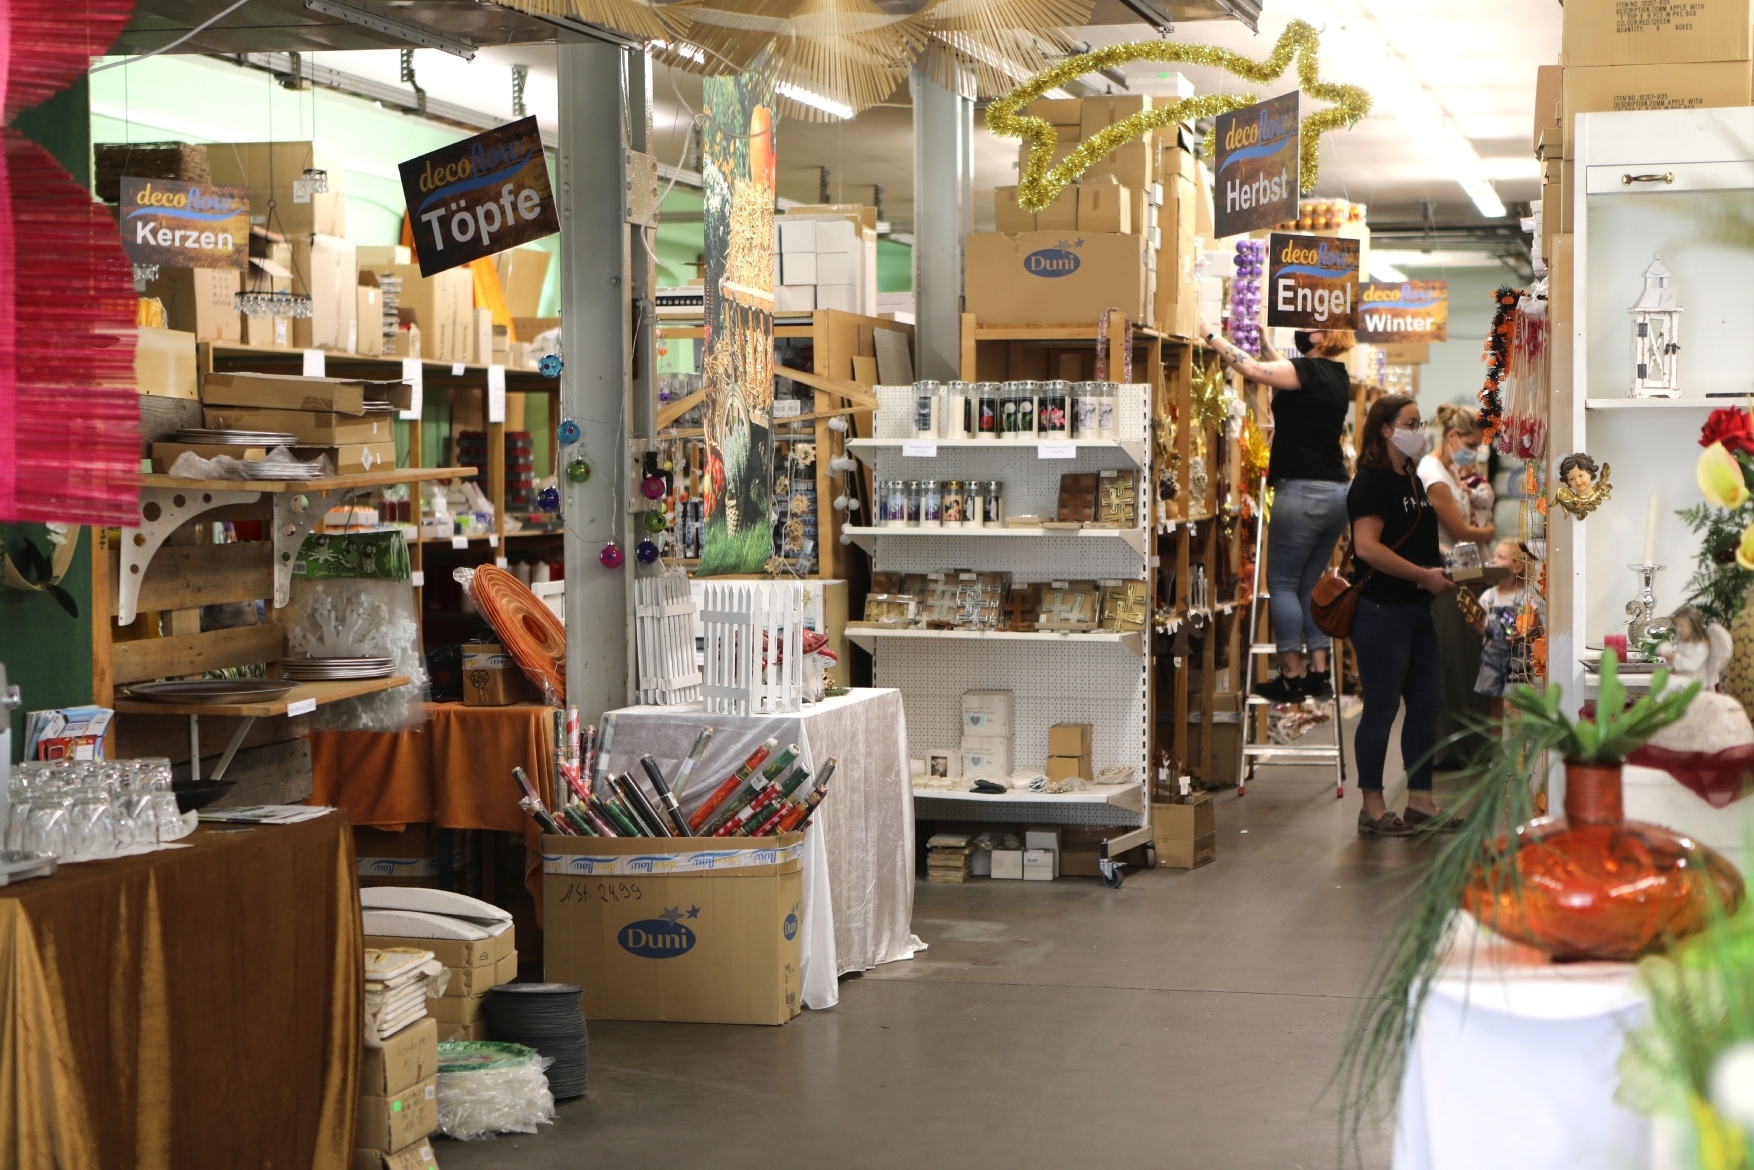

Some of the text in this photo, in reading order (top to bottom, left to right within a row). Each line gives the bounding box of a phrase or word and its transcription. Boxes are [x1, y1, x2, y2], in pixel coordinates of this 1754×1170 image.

[1225, 109, 1290, 151] decoflow
[419, 139, 522, 192] decoflow
[136, 183, 233, 211] decoflow
[1227, 167, 1288, 213] Herbst
[421, 183, 541, 251] Töpfe
[136, 220, 233, 251] Kerzen
[1030, 254, 1075, 271] Duni
[1281, 239, 1347, 269] decoflow
[1277, 278, 1351, 322] Engel
[1363, 284, 1433, 303] decoflow
[1365, 313, 1435, 333] Winter
[573, 860, 617, 874] decoflow
[631, 859, 677, 873] decoflow
[627, 928, 688, 949] Duni
[784, 918, 797, 936] Duni
